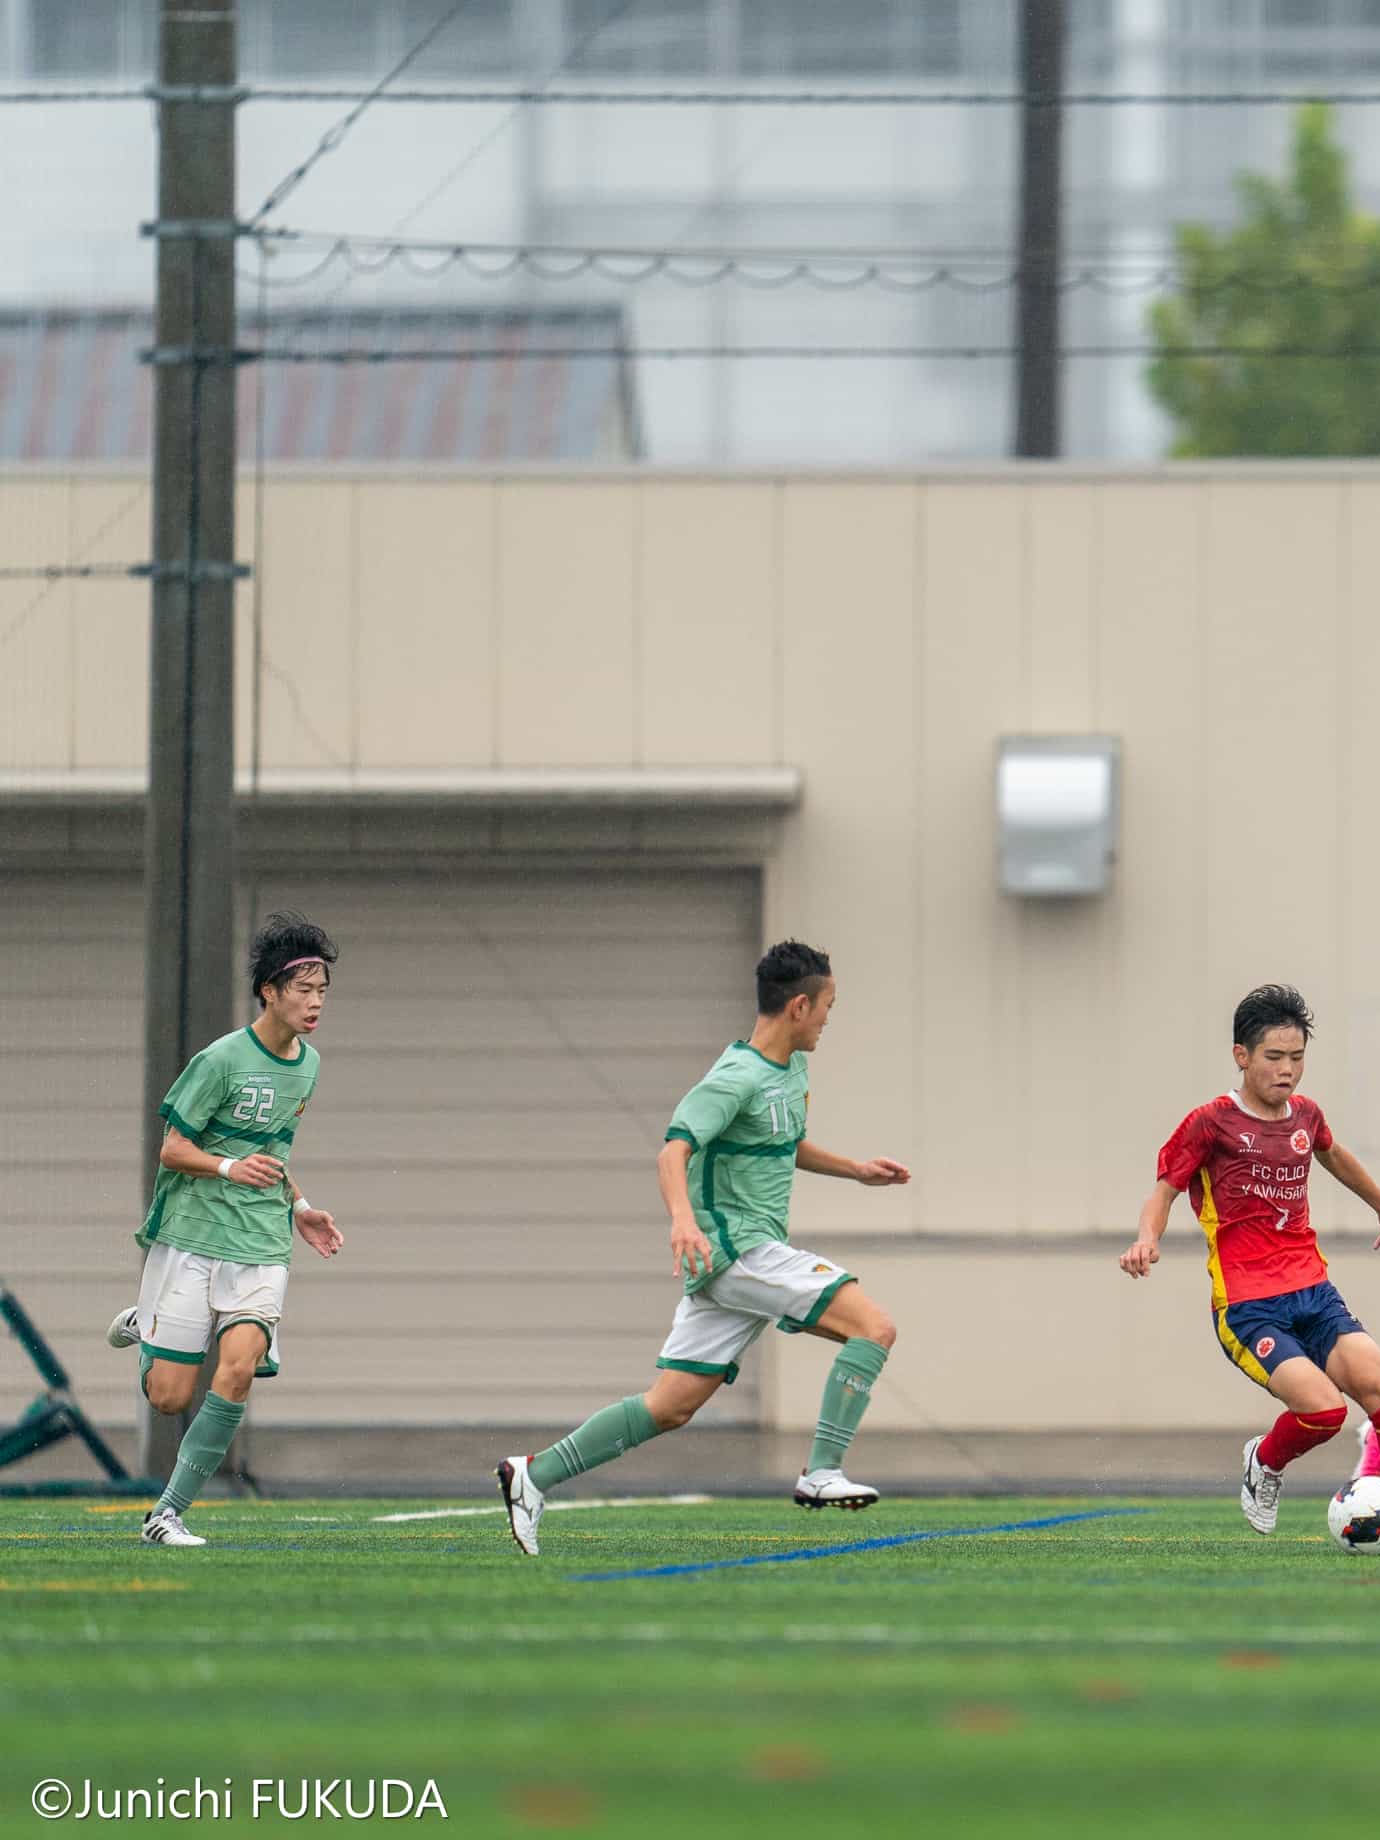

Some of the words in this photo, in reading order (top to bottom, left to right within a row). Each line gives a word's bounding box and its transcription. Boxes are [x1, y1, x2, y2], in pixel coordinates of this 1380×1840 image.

[233, 1087, 275, 1123] 22
[1251, 1163, 1271, 1180] FC
[1276, 1165, 1305, 1182] CLIO
